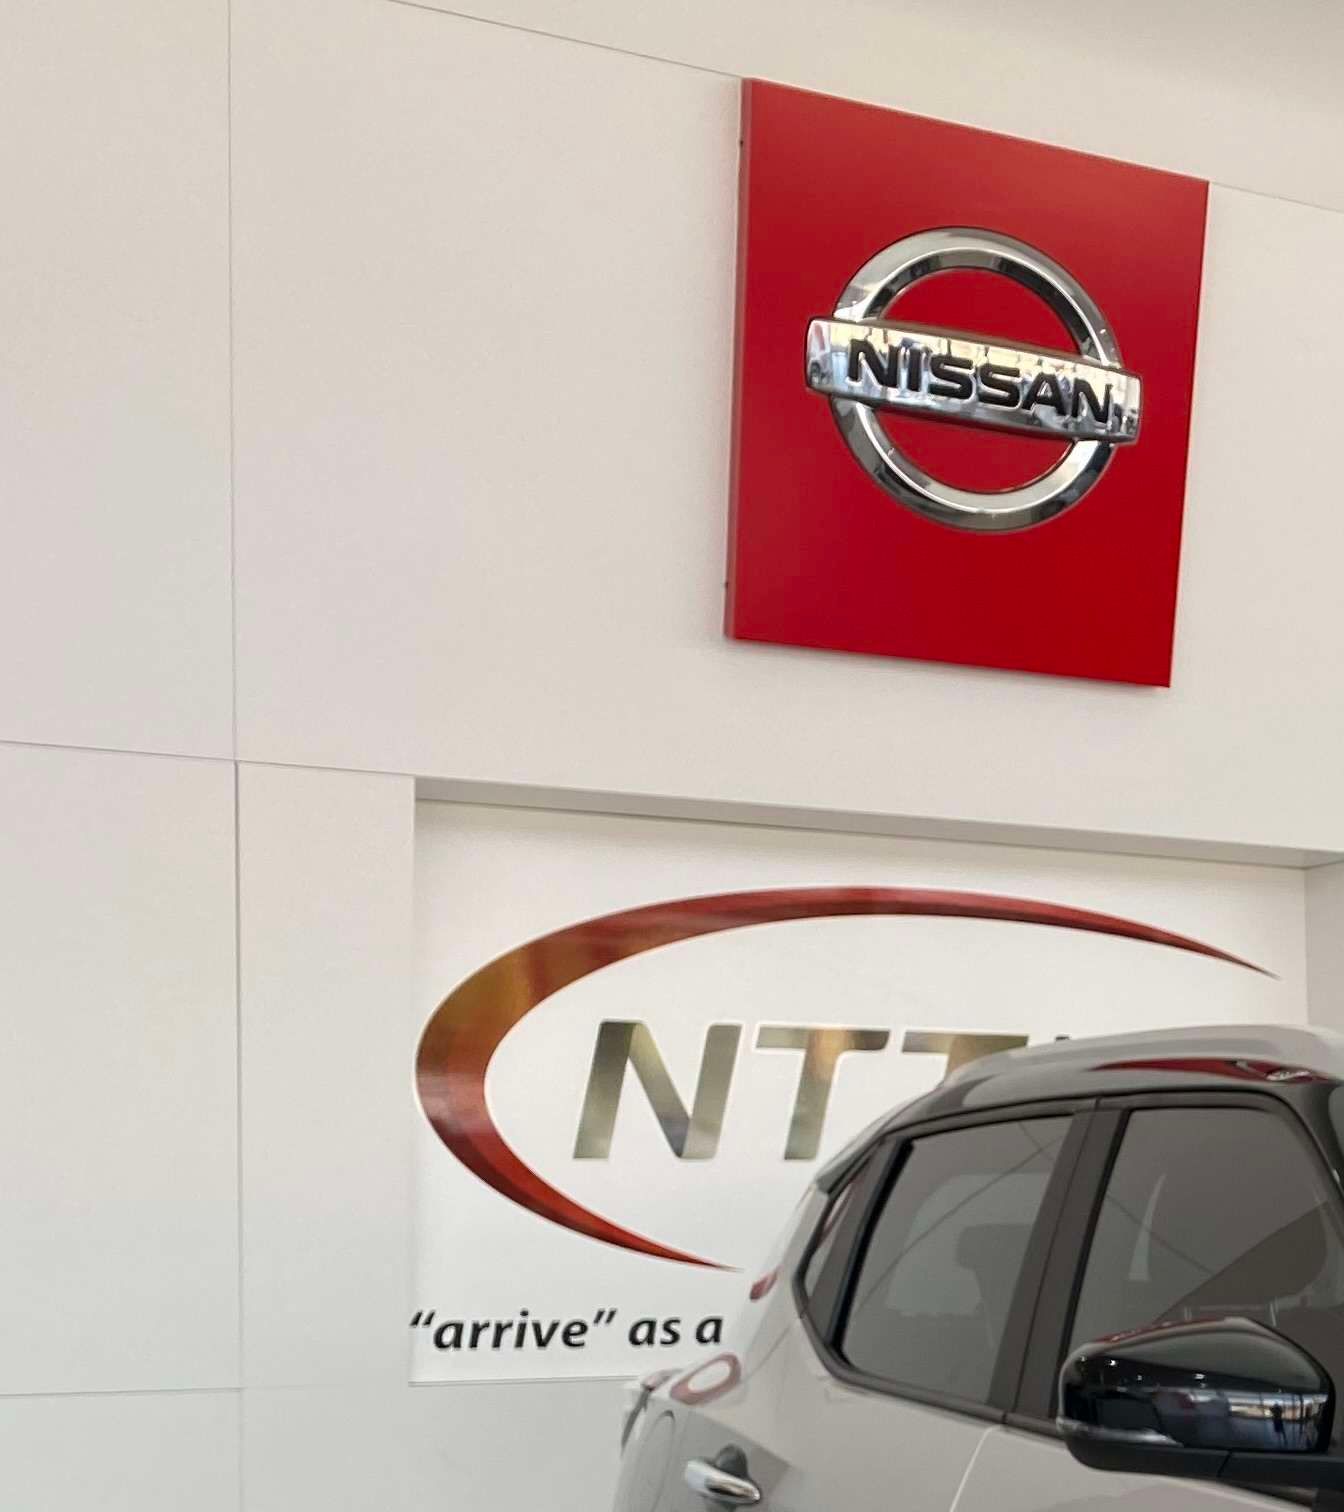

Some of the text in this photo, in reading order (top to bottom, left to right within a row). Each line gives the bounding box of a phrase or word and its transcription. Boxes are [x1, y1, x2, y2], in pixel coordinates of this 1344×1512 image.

[849, 339, 1113, 424] NISSAN
[628, 1315, 682, 1346] as
[695, 1316, 724, 1345] a
